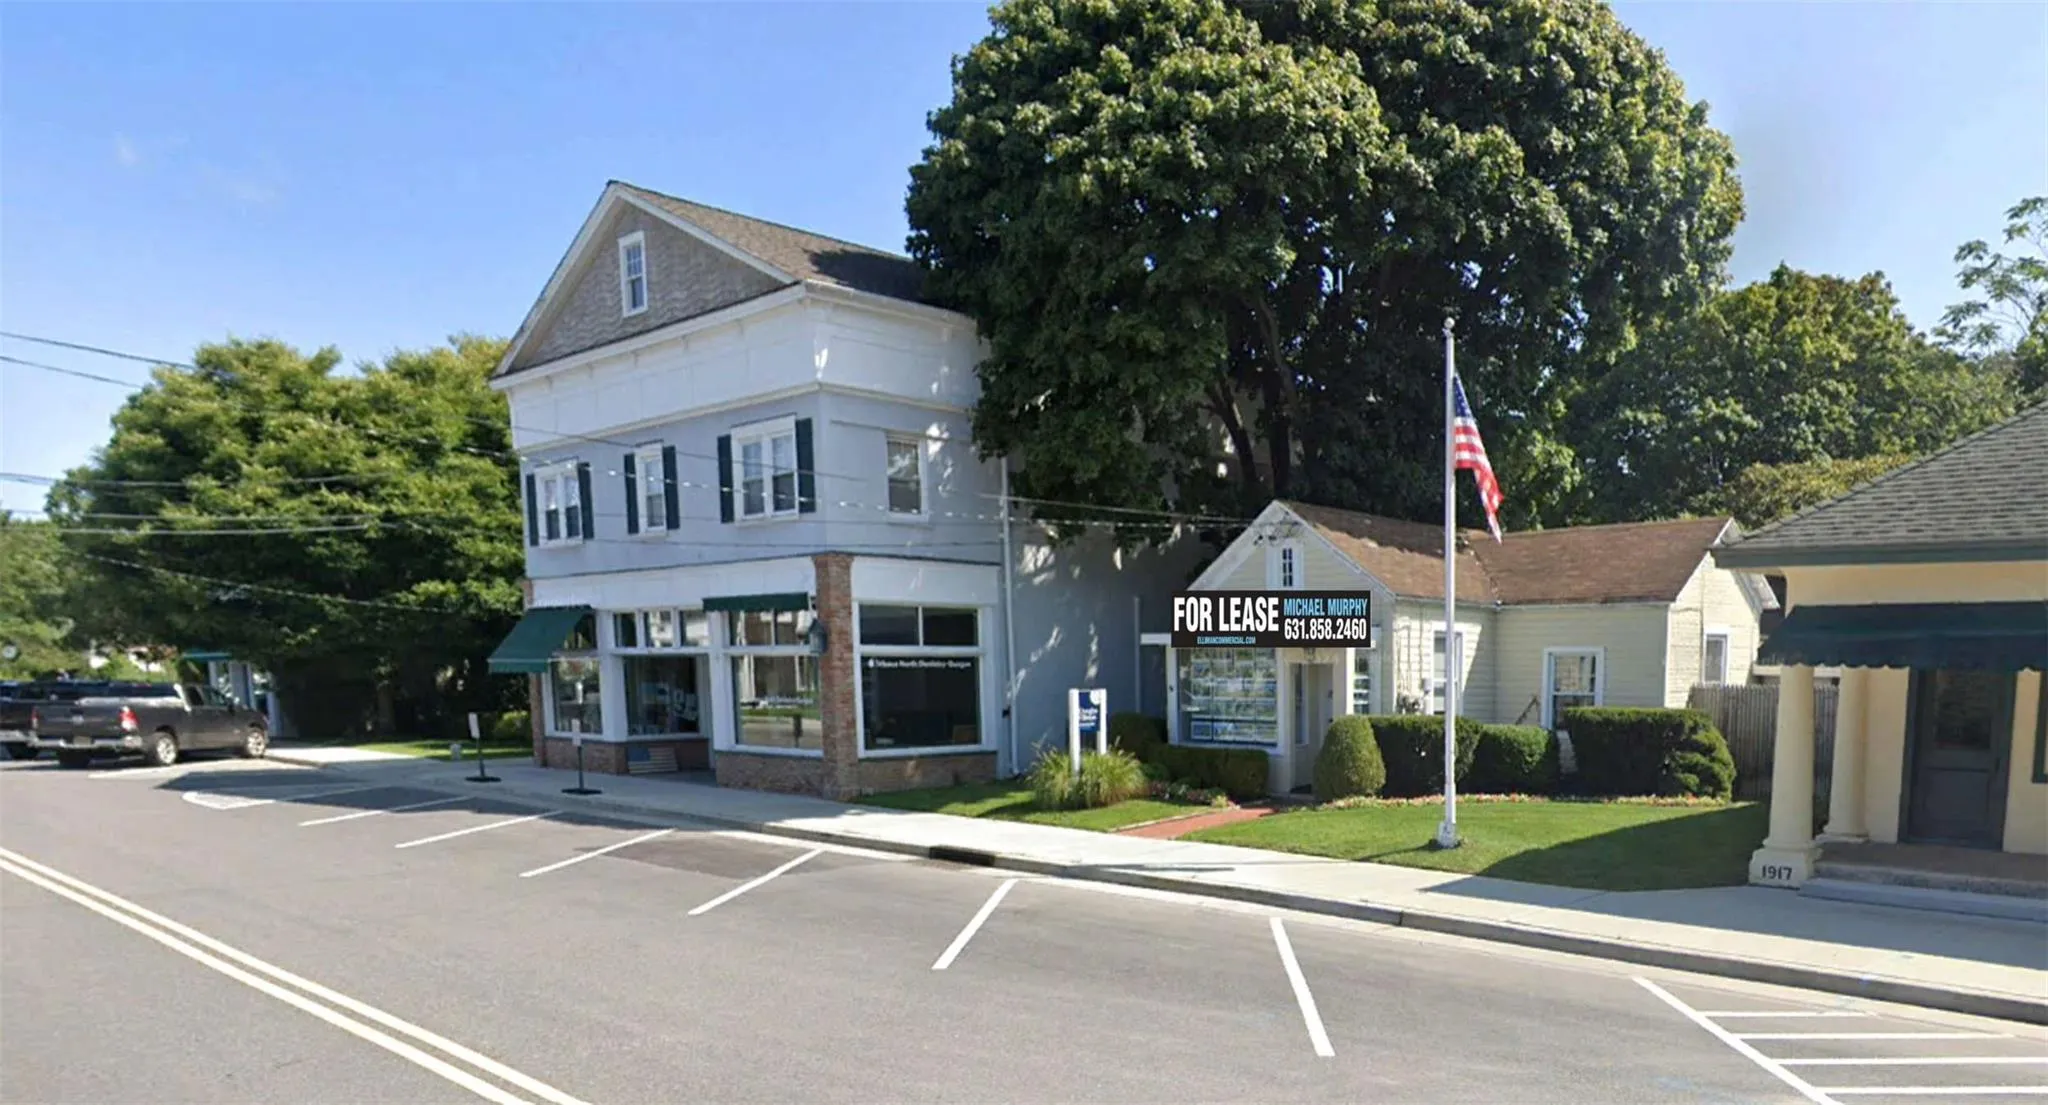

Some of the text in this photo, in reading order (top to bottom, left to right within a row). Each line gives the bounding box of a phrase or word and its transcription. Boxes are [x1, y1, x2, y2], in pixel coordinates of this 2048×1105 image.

[1173, 596, 1280, 632] FOR LEASE
[1283, 598, 1368, 616] MICHAEL MURPHY
[1284, 618, 1367, 640] 631.858.2460
[1762, 865, 1793, 880] 1917
